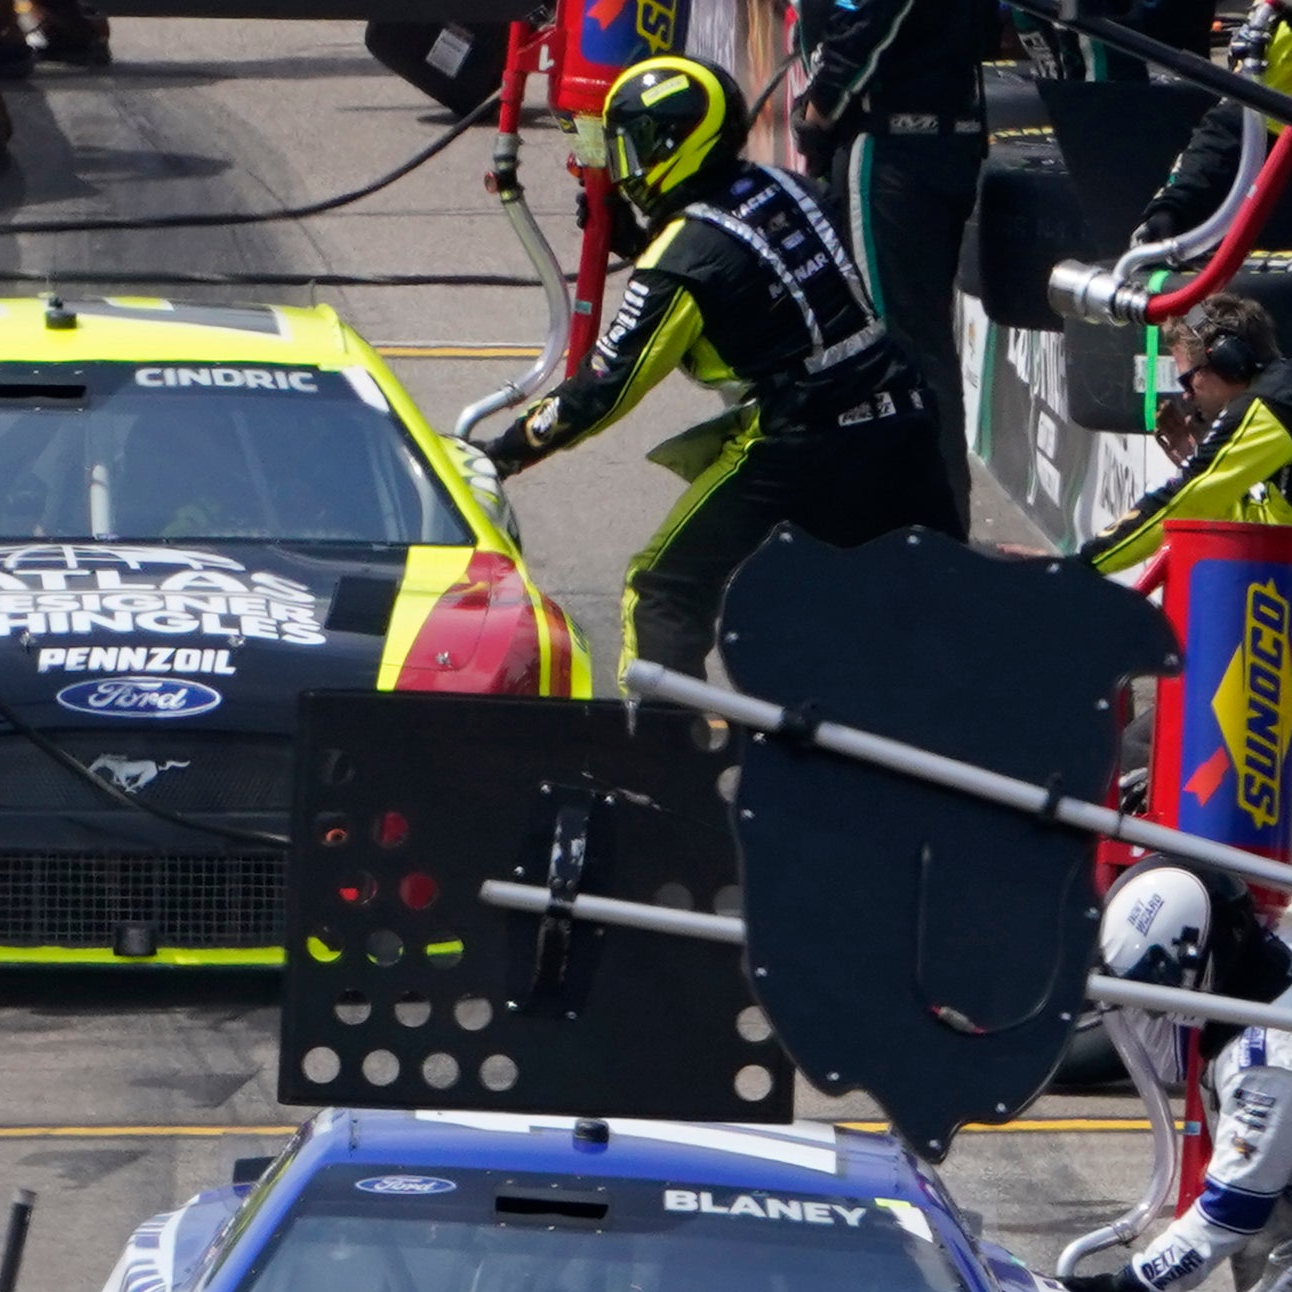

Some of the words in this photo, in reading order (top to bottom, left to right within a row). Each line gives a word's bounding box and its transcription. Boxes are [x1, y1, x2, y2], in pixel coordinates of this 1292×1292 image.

[135, 368, 319, 393] CINDRIC
[38, 646, 236, 675] PENNZOIL
[87, 681, 187, 712] Ford
[1243, 593, 1289, 816] SUNOCO
[374, 1176, 440, 1195] Ford
[664, 1189, 866, 1228] BLANEY
